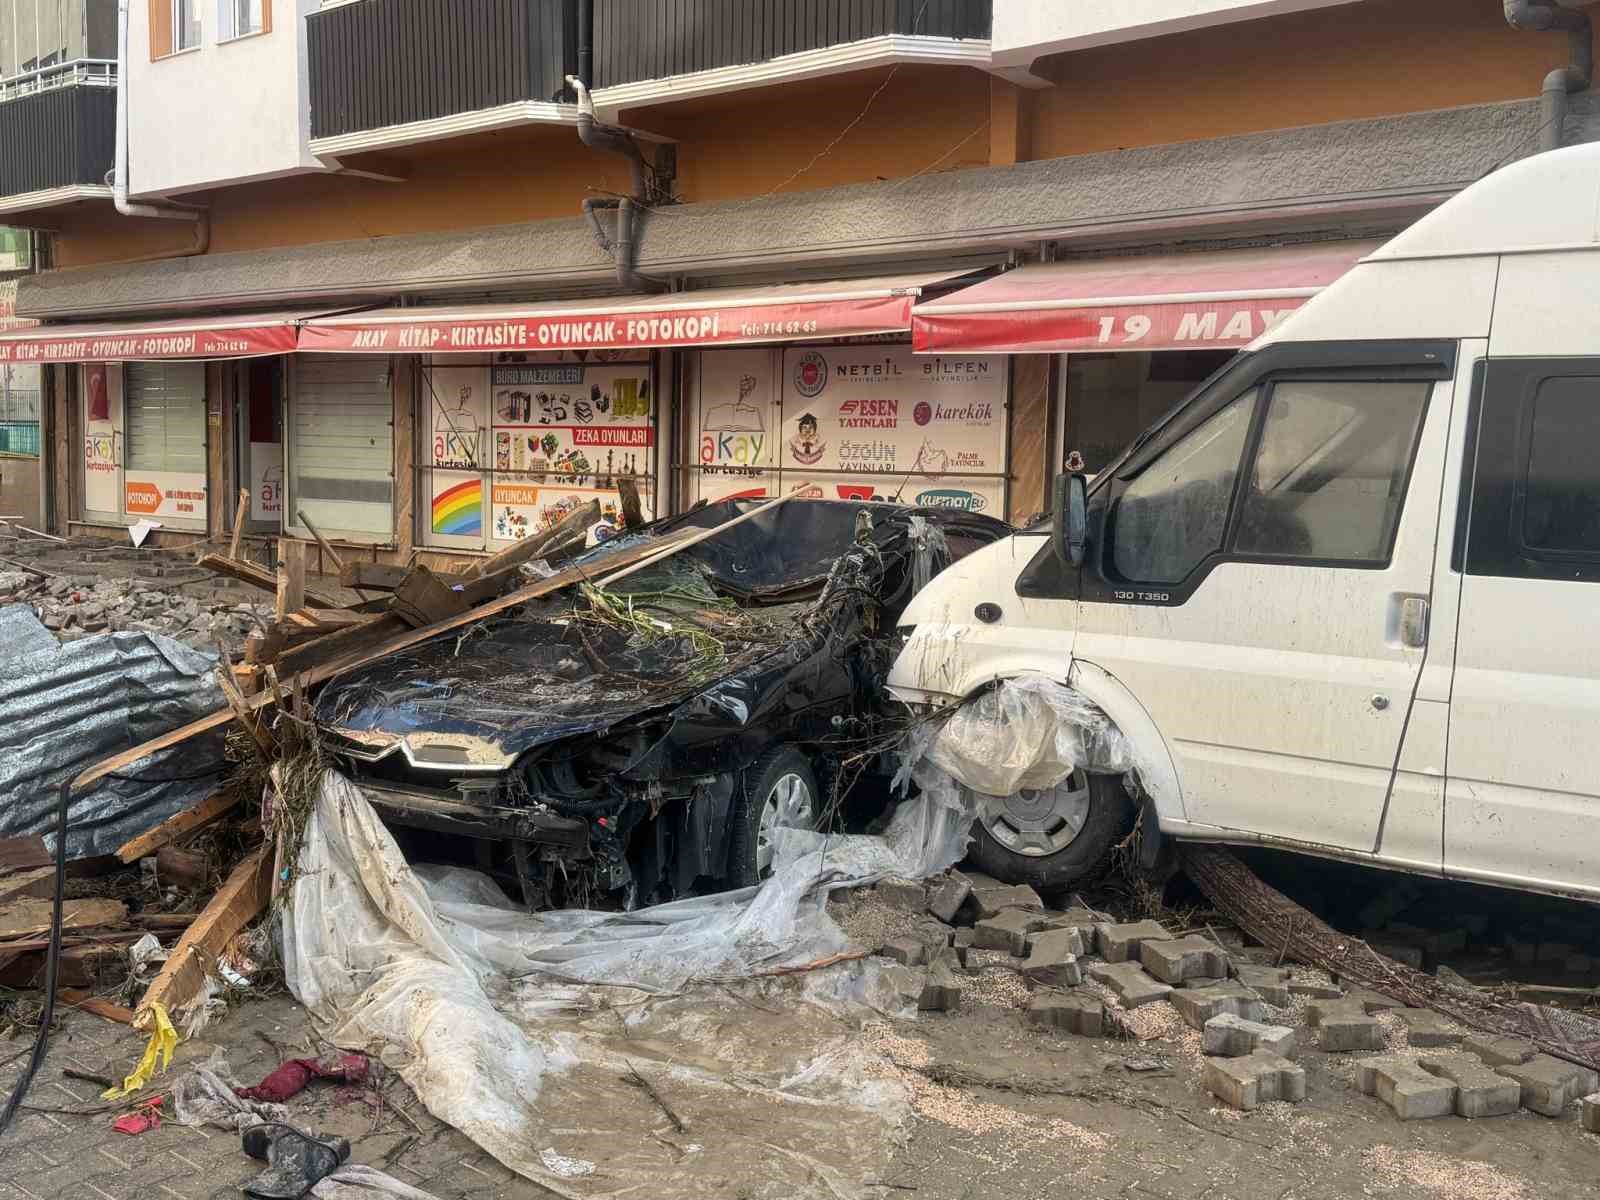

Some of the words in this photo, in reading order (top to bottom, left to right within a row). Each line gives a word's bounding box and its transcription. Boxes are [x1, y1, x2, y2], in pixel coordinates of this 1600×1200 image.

[352, 330, 388, 347] AKAY
[398, 326, 440, 347] KİTAP
[451, 322, 527, 346] KIRTASİYE
[538, 321, 615, 344] OYUNCAK
[627, 312, 719, 342] FOTOKOPİ
[1097, 314, 1151, 343] 19
[16, 342, 39, 359] KİTAP
[44, 340, 87, 358] KIRTASİYE
[92, 339, 137, 356] OYUNCAK
[142, 333, 196, 353] FOTOKOPİ
[860, 400, 898, 416] ESEN
[935, 402, 992, 419] karekök
[839, 419, 896, 429] YAYINLARI
[575, 429, 600, 443] ZEKA
[602, 430, 648, 445] OYUNLARI
[701, 431, 763, 466] akay
[1114, 591, 1134, 599] 130
[1136, 592, 1169, 601] T350
